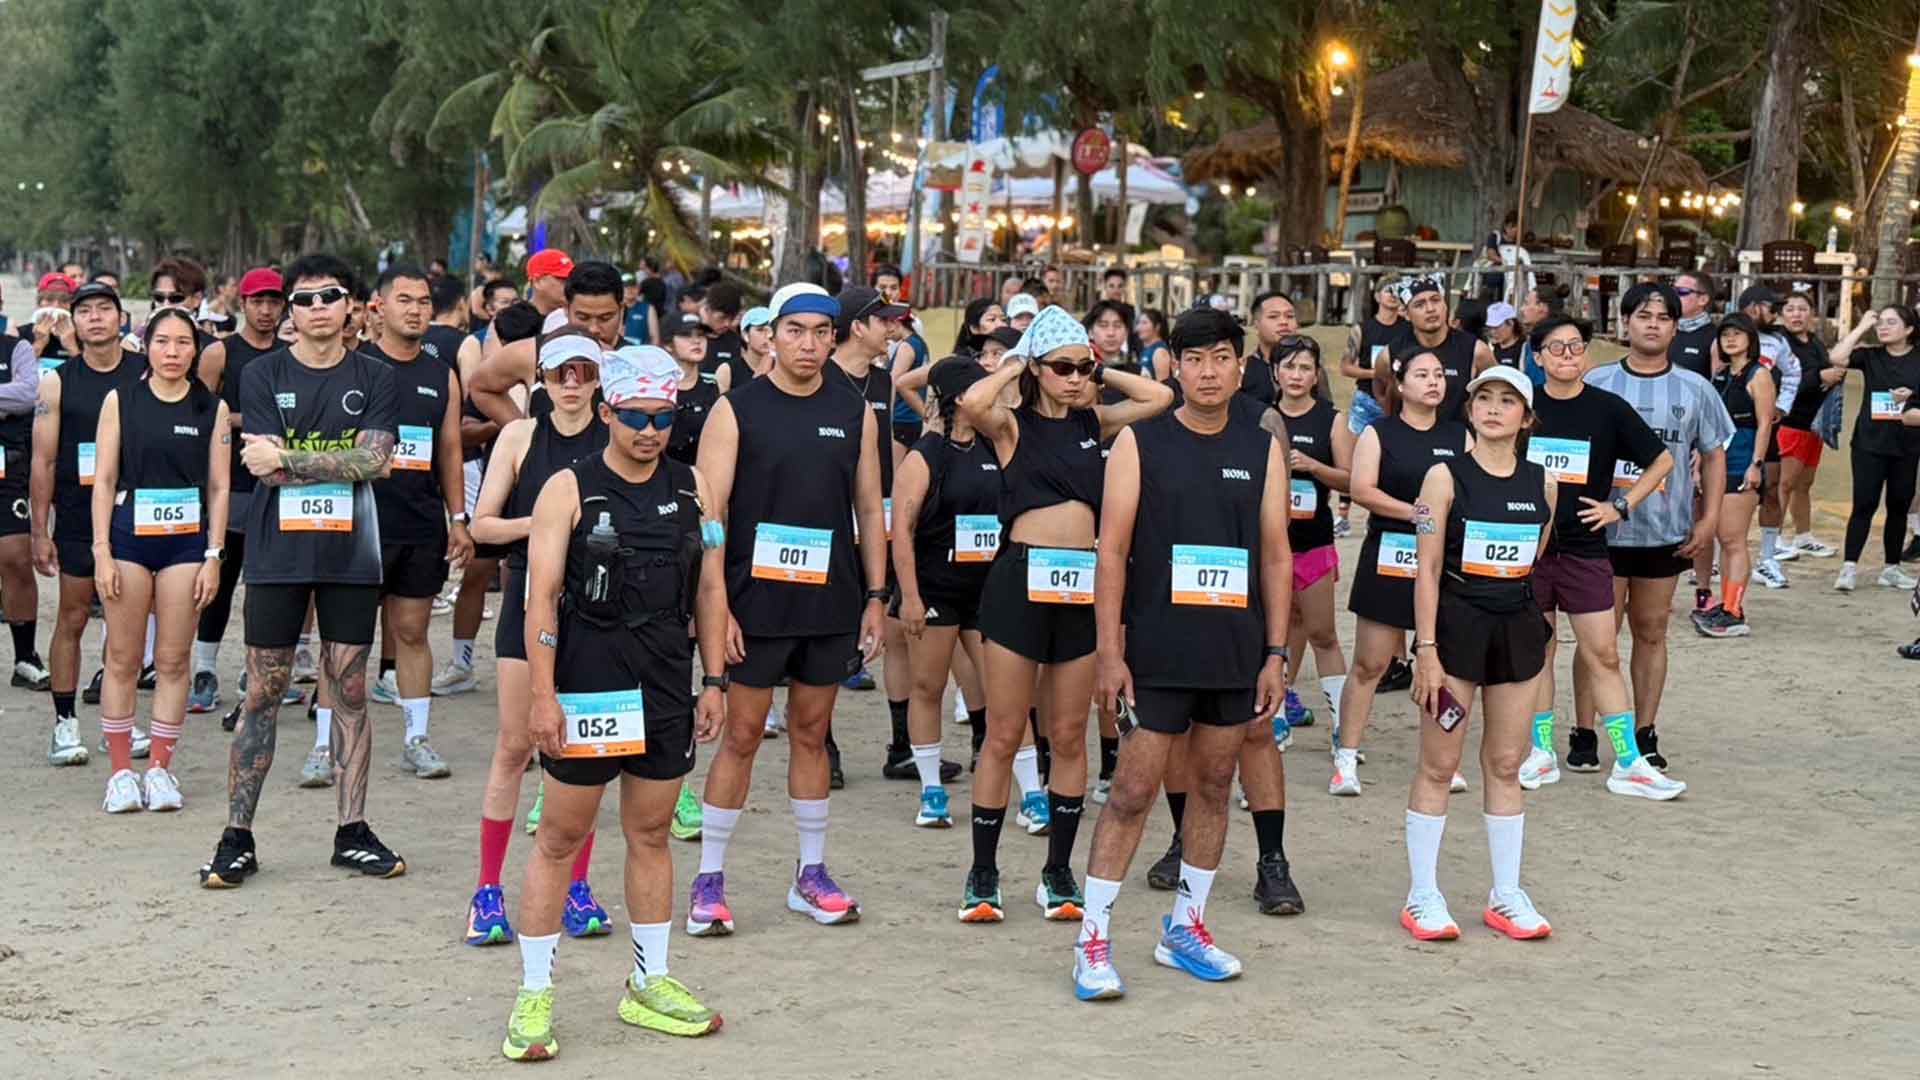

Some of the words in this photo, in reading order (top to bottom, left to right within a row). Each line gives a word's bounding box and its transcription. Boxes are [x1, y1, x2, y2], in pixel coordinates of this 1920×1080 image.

[818, 427, 846, 439] NOMA
[1544, 454, 1570, 469] 019
[1222, 468, 1251, 481] NOMA
[153, 505, 185, 522] 065
[300, 498, 334, 515] 058
[1507, 501, 1536, 512] NOMA
[974, 532, 996, 548] 010
[779, 547, 808, 567] 001
[1485, 543, 1519, 562] 022
[1050, 569, 1080, 588] 047
[1198, 568, 1229, 588] 077
[578, 716, 619, 738] 052
